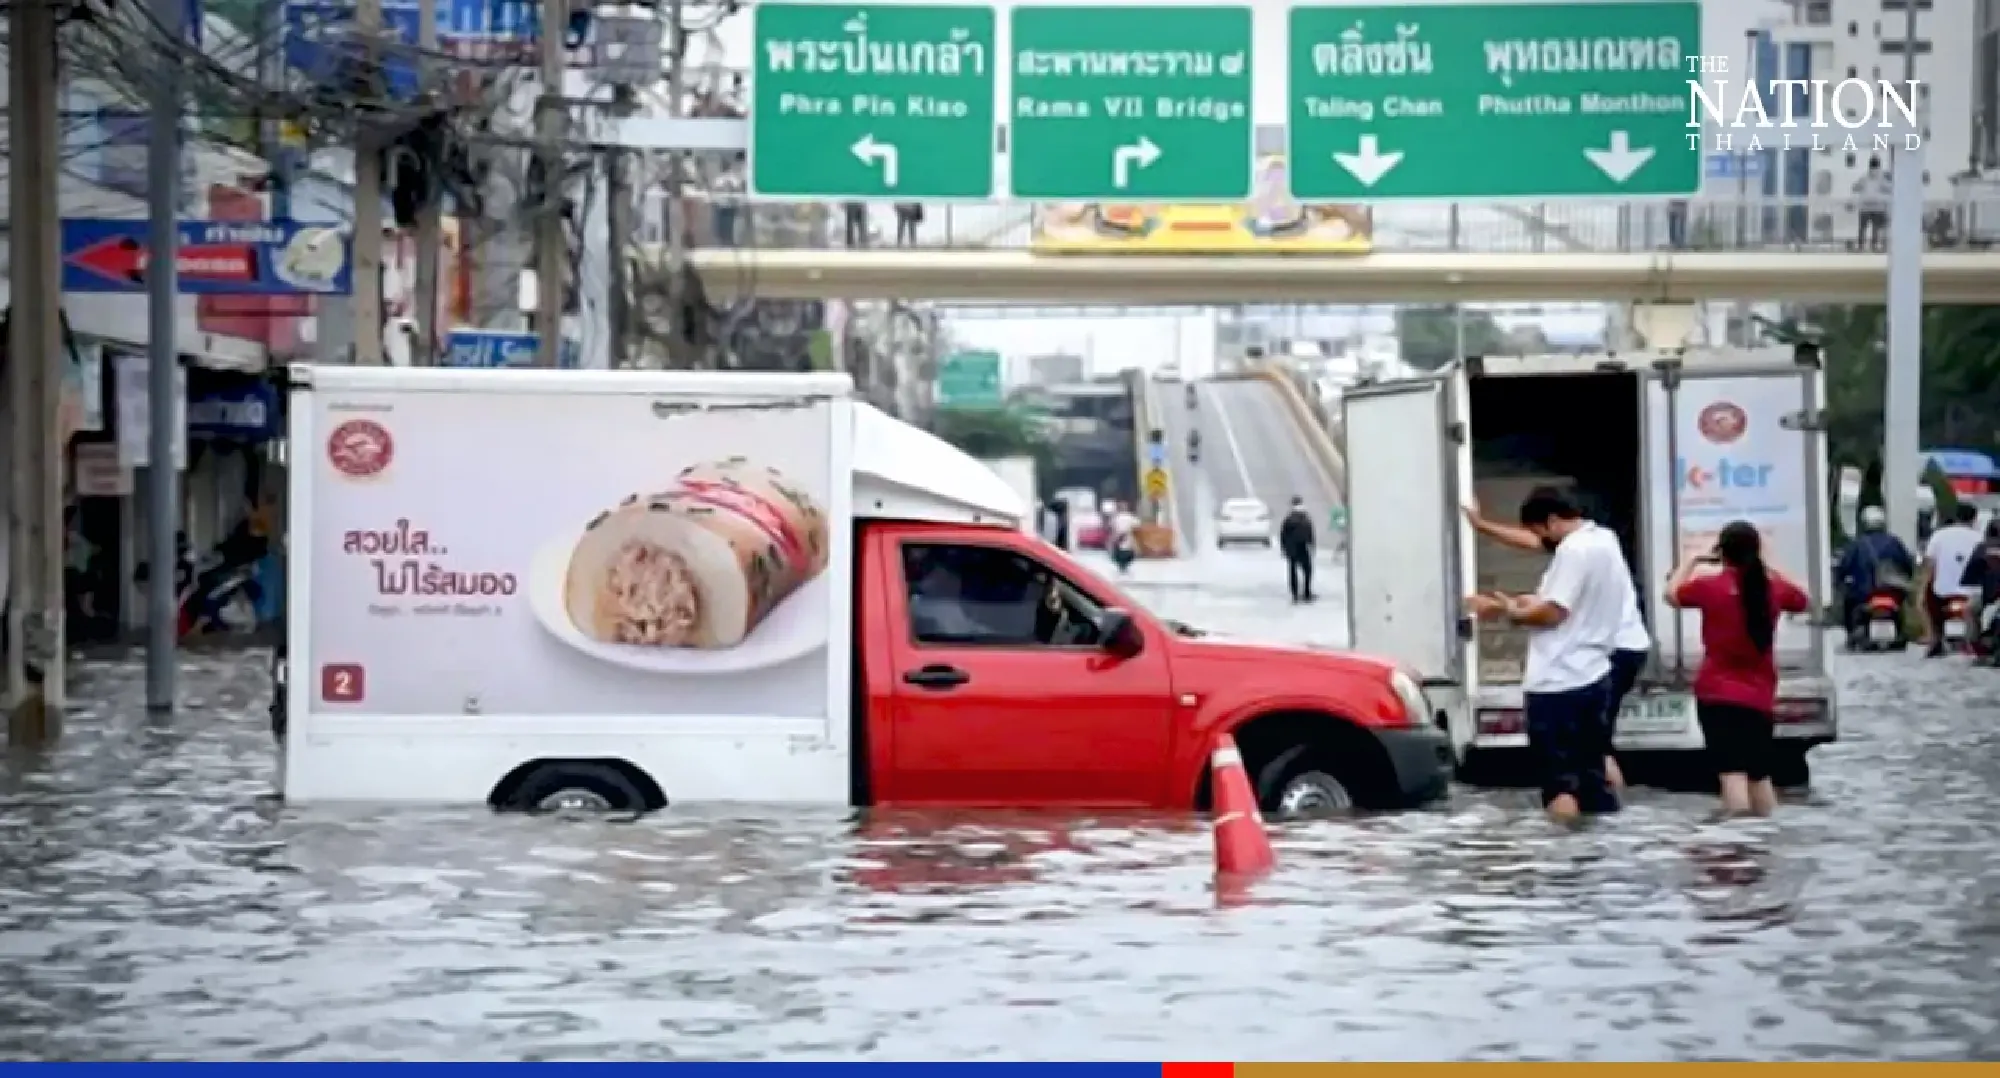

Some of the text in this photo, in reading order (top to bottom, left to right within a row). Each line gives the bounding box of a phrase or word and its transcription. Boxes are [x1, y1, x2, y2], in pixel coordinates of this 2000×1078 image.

[766, 10, 984, 75] พระปิ่นเกล้า
[1312, 19, 1433, 75] ตลิ่งชัน
[1018, 49, 1213, 77] สะพานพระราม
[1484, 35, 1681, 88] พุทธมณฑล
[780, 92, 842, 116] Phra
[852, 94, 896, 117] Pin
[1017, 96, 1245, 122] Rama VII Bridge
[1304, 96, 1443, 121] Taling Chan
[1478, 91, 1685, 114] Phuttha Monthon
[334, 669, 353, 695] 2
